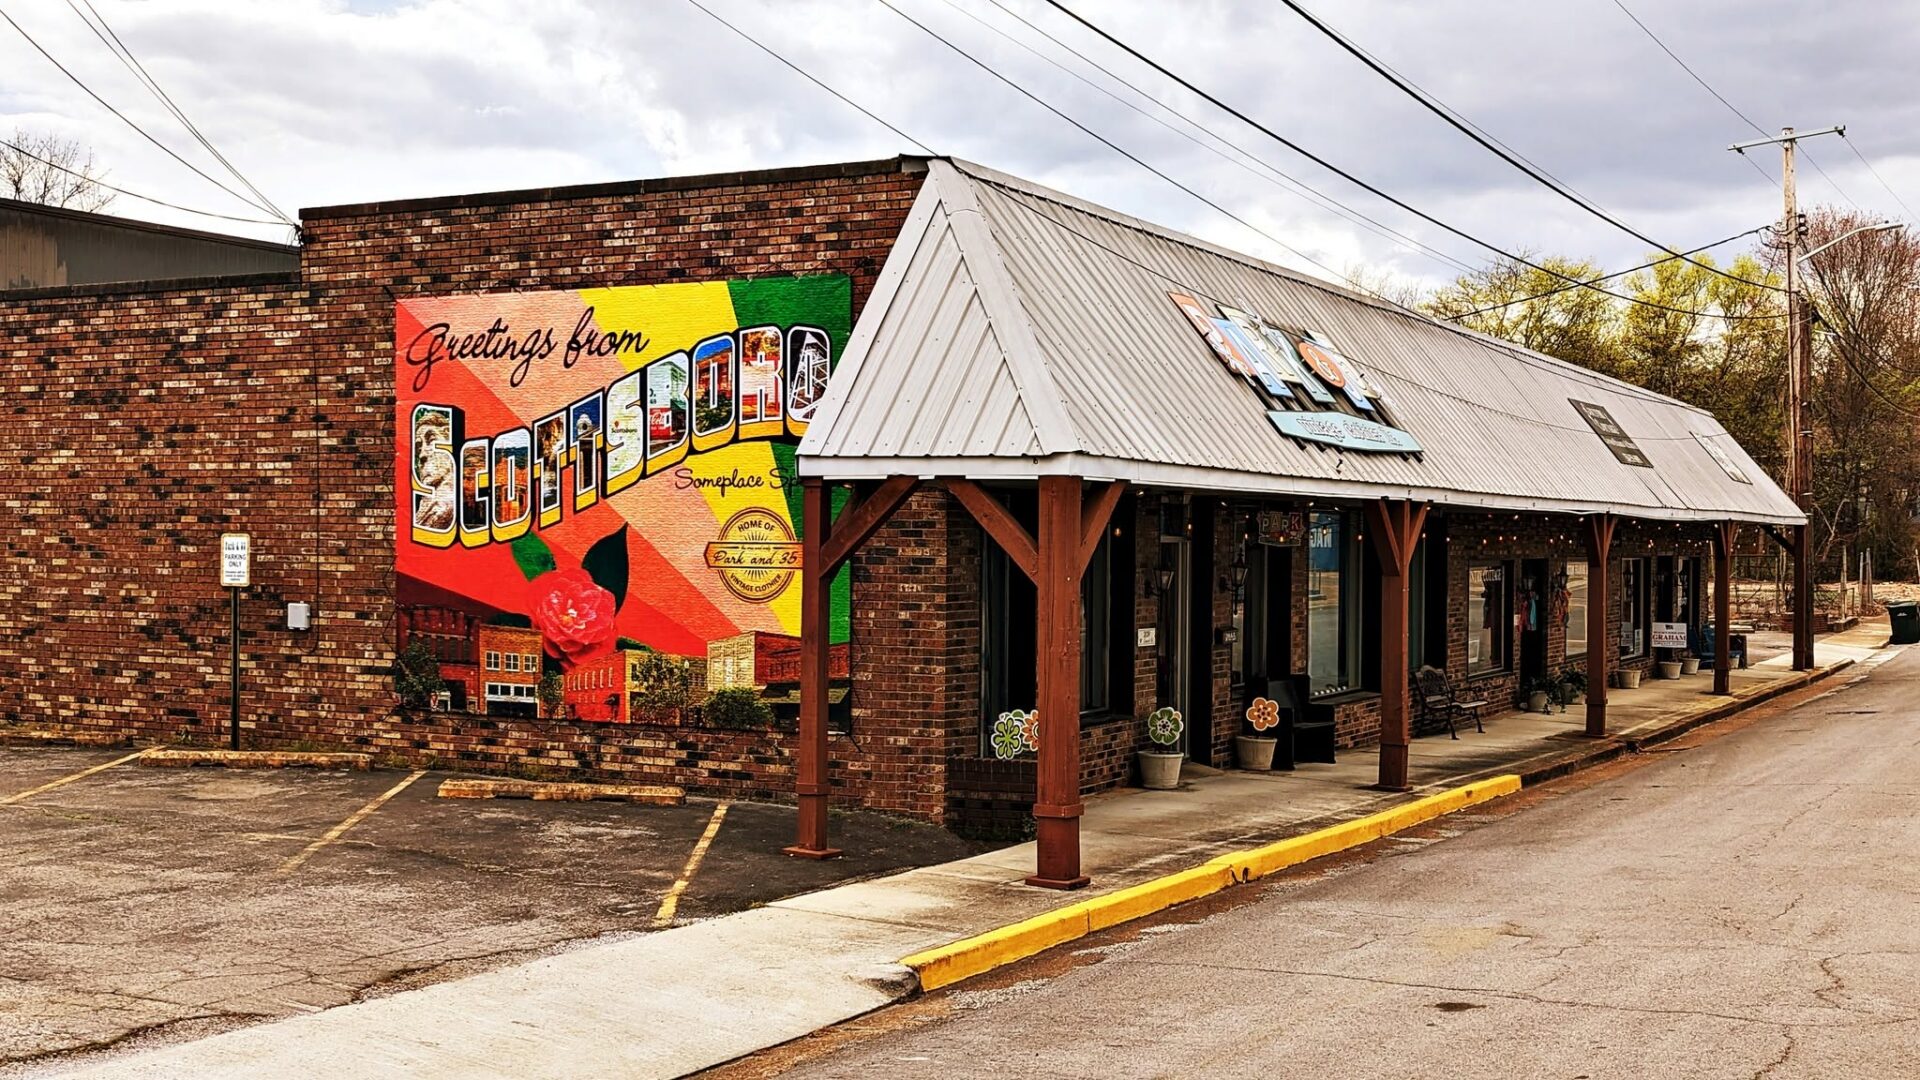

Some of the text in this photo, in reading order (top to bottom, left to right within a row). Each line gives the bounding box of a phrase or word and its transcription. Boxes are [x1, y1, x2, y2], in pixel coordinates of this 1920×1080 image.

[406, 306, 649, 393] Greetings from
[674, 467, 764, 497] Someplace
[738, 520, 775, 532] HOME OF
[1262, 514, 1299, 532] PARK
[713, 550, 798, 565] Park and 35
[730, 573, 782, 592] VINTAGE CLOTHIER
